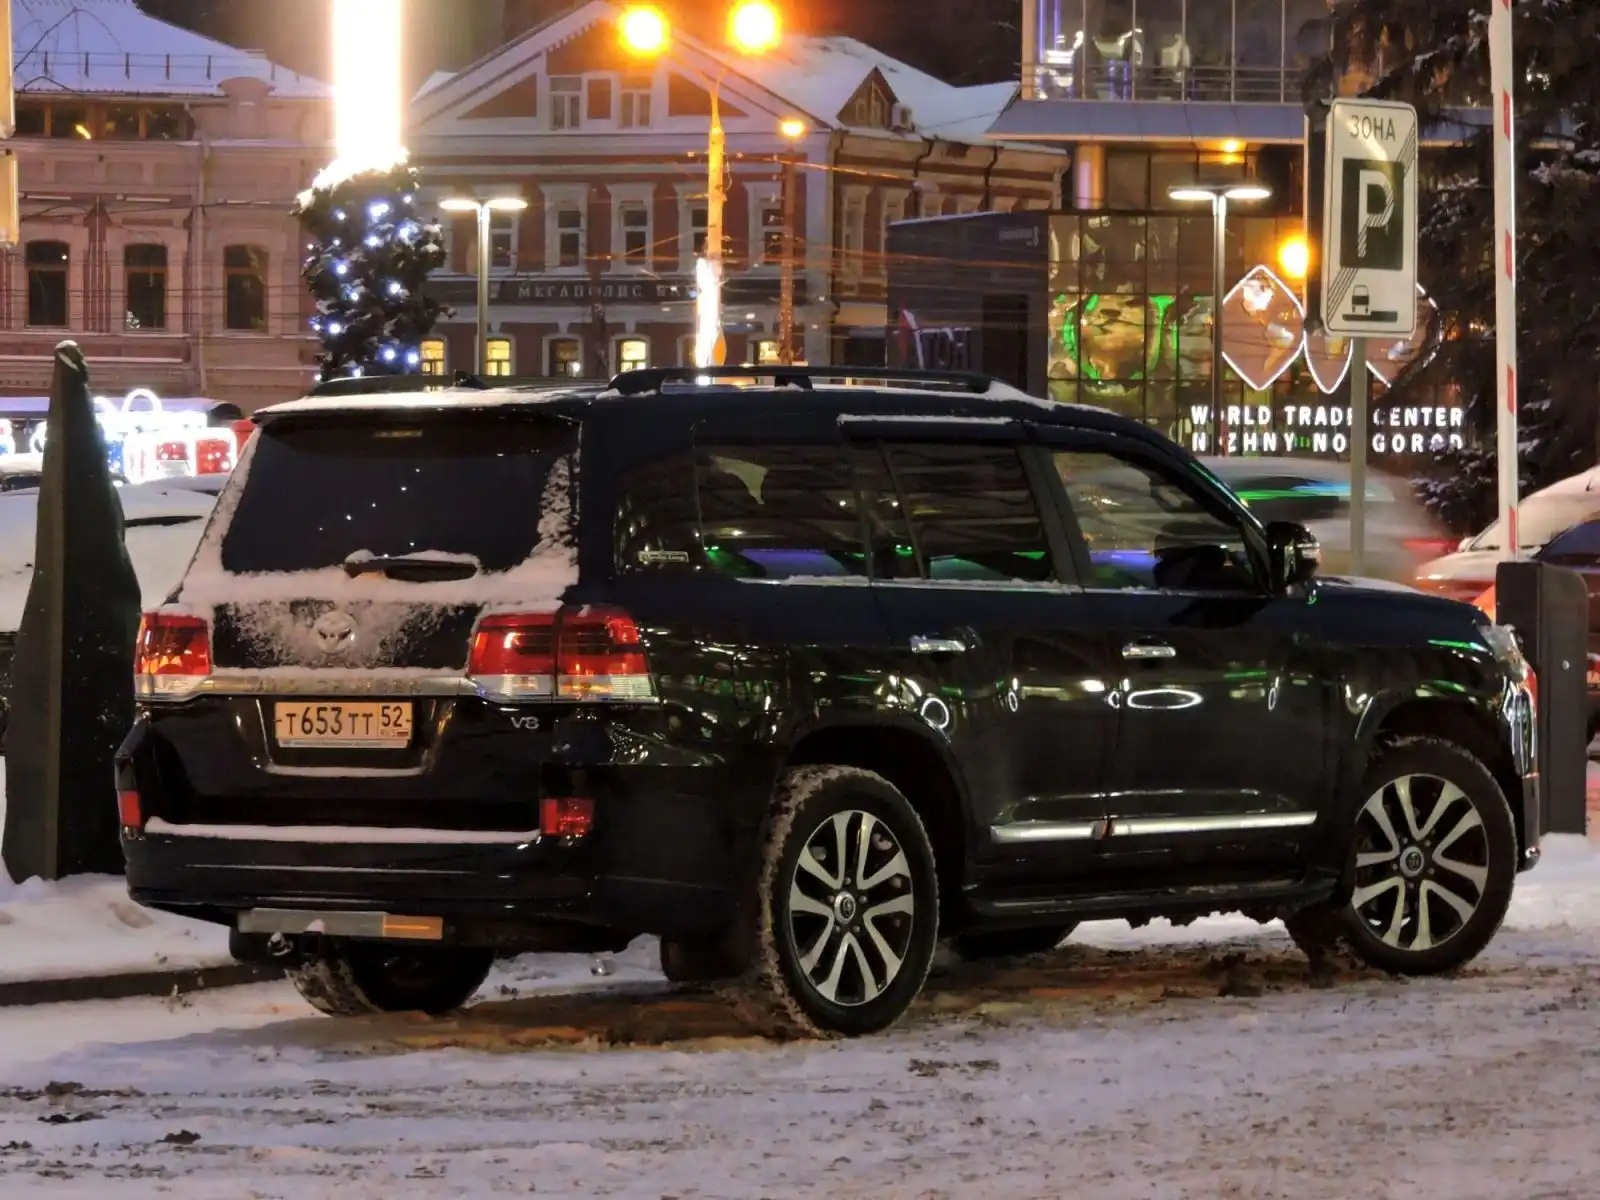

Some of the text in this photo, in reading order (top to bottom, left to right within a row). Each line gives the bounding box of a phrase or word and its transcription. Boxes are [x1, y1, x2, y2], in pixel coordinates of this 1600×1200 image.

[1349, 114, 1396, 142] ЗОНА
[1357, 169, 1394, 258] P
[1373, 407, 1464, 427] CENTER
[1191, 432, 1463, 453] NZHNY NOGOROD
[510, 716, 540, 729] V8
